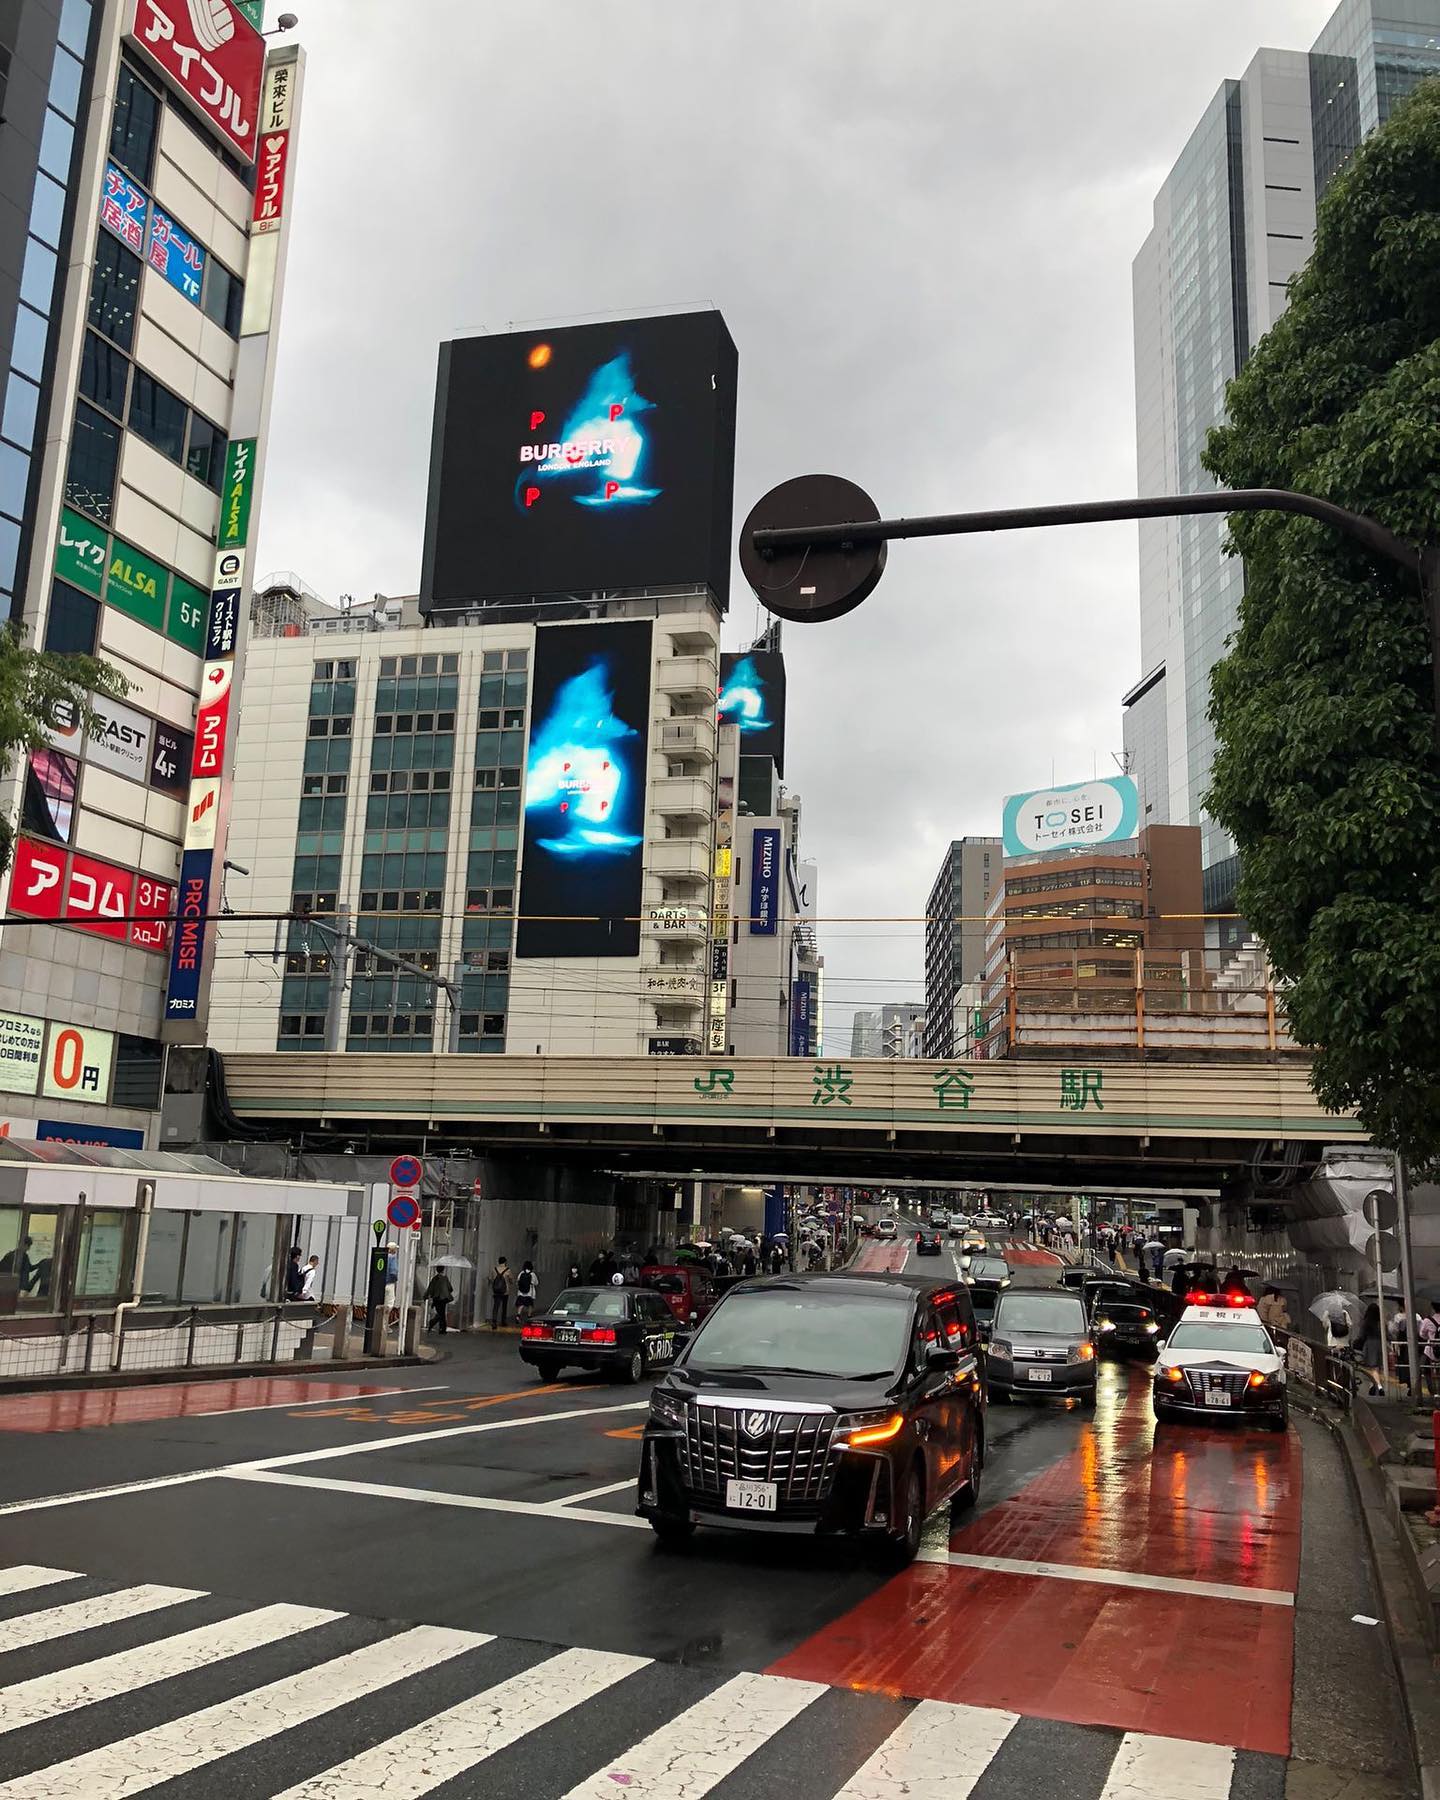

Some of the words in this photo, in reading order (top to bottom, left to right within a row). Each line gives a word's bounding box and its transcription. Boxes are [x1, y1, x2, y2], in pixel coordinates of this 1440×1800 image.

[145, 0, 250, 137] アイフル
[261, 153, 282, 218] アイフル
[101, 195, 168, 275] 居酒屋
[259, 221, 274, 231] 8F
[183, 272, 200, 297] 7F
[109, 559, 156, 599] ALSA
[181, 602, 201, 628] 5F
[201, 716, 221, 768] アコム
[155, 750, 176, 778] 4F
[762, 836, 773, 878] MIZUHO
[27, 859, 125, 917] アコム
[139, 882, 167, 909] 3F
[178, 879, 203, 969] PROMISE
[650, 910, 687, 919] DARTS
[664, 920, 686, 929] BAR
[133, 927, 151, 944] 入口
[712, 982, 726, 992] 3F
[169, 999, 195, 1009] プロミス
[694, 1069, 735, 1092] JR
[739, 1492, 772, 1509] 12-01
